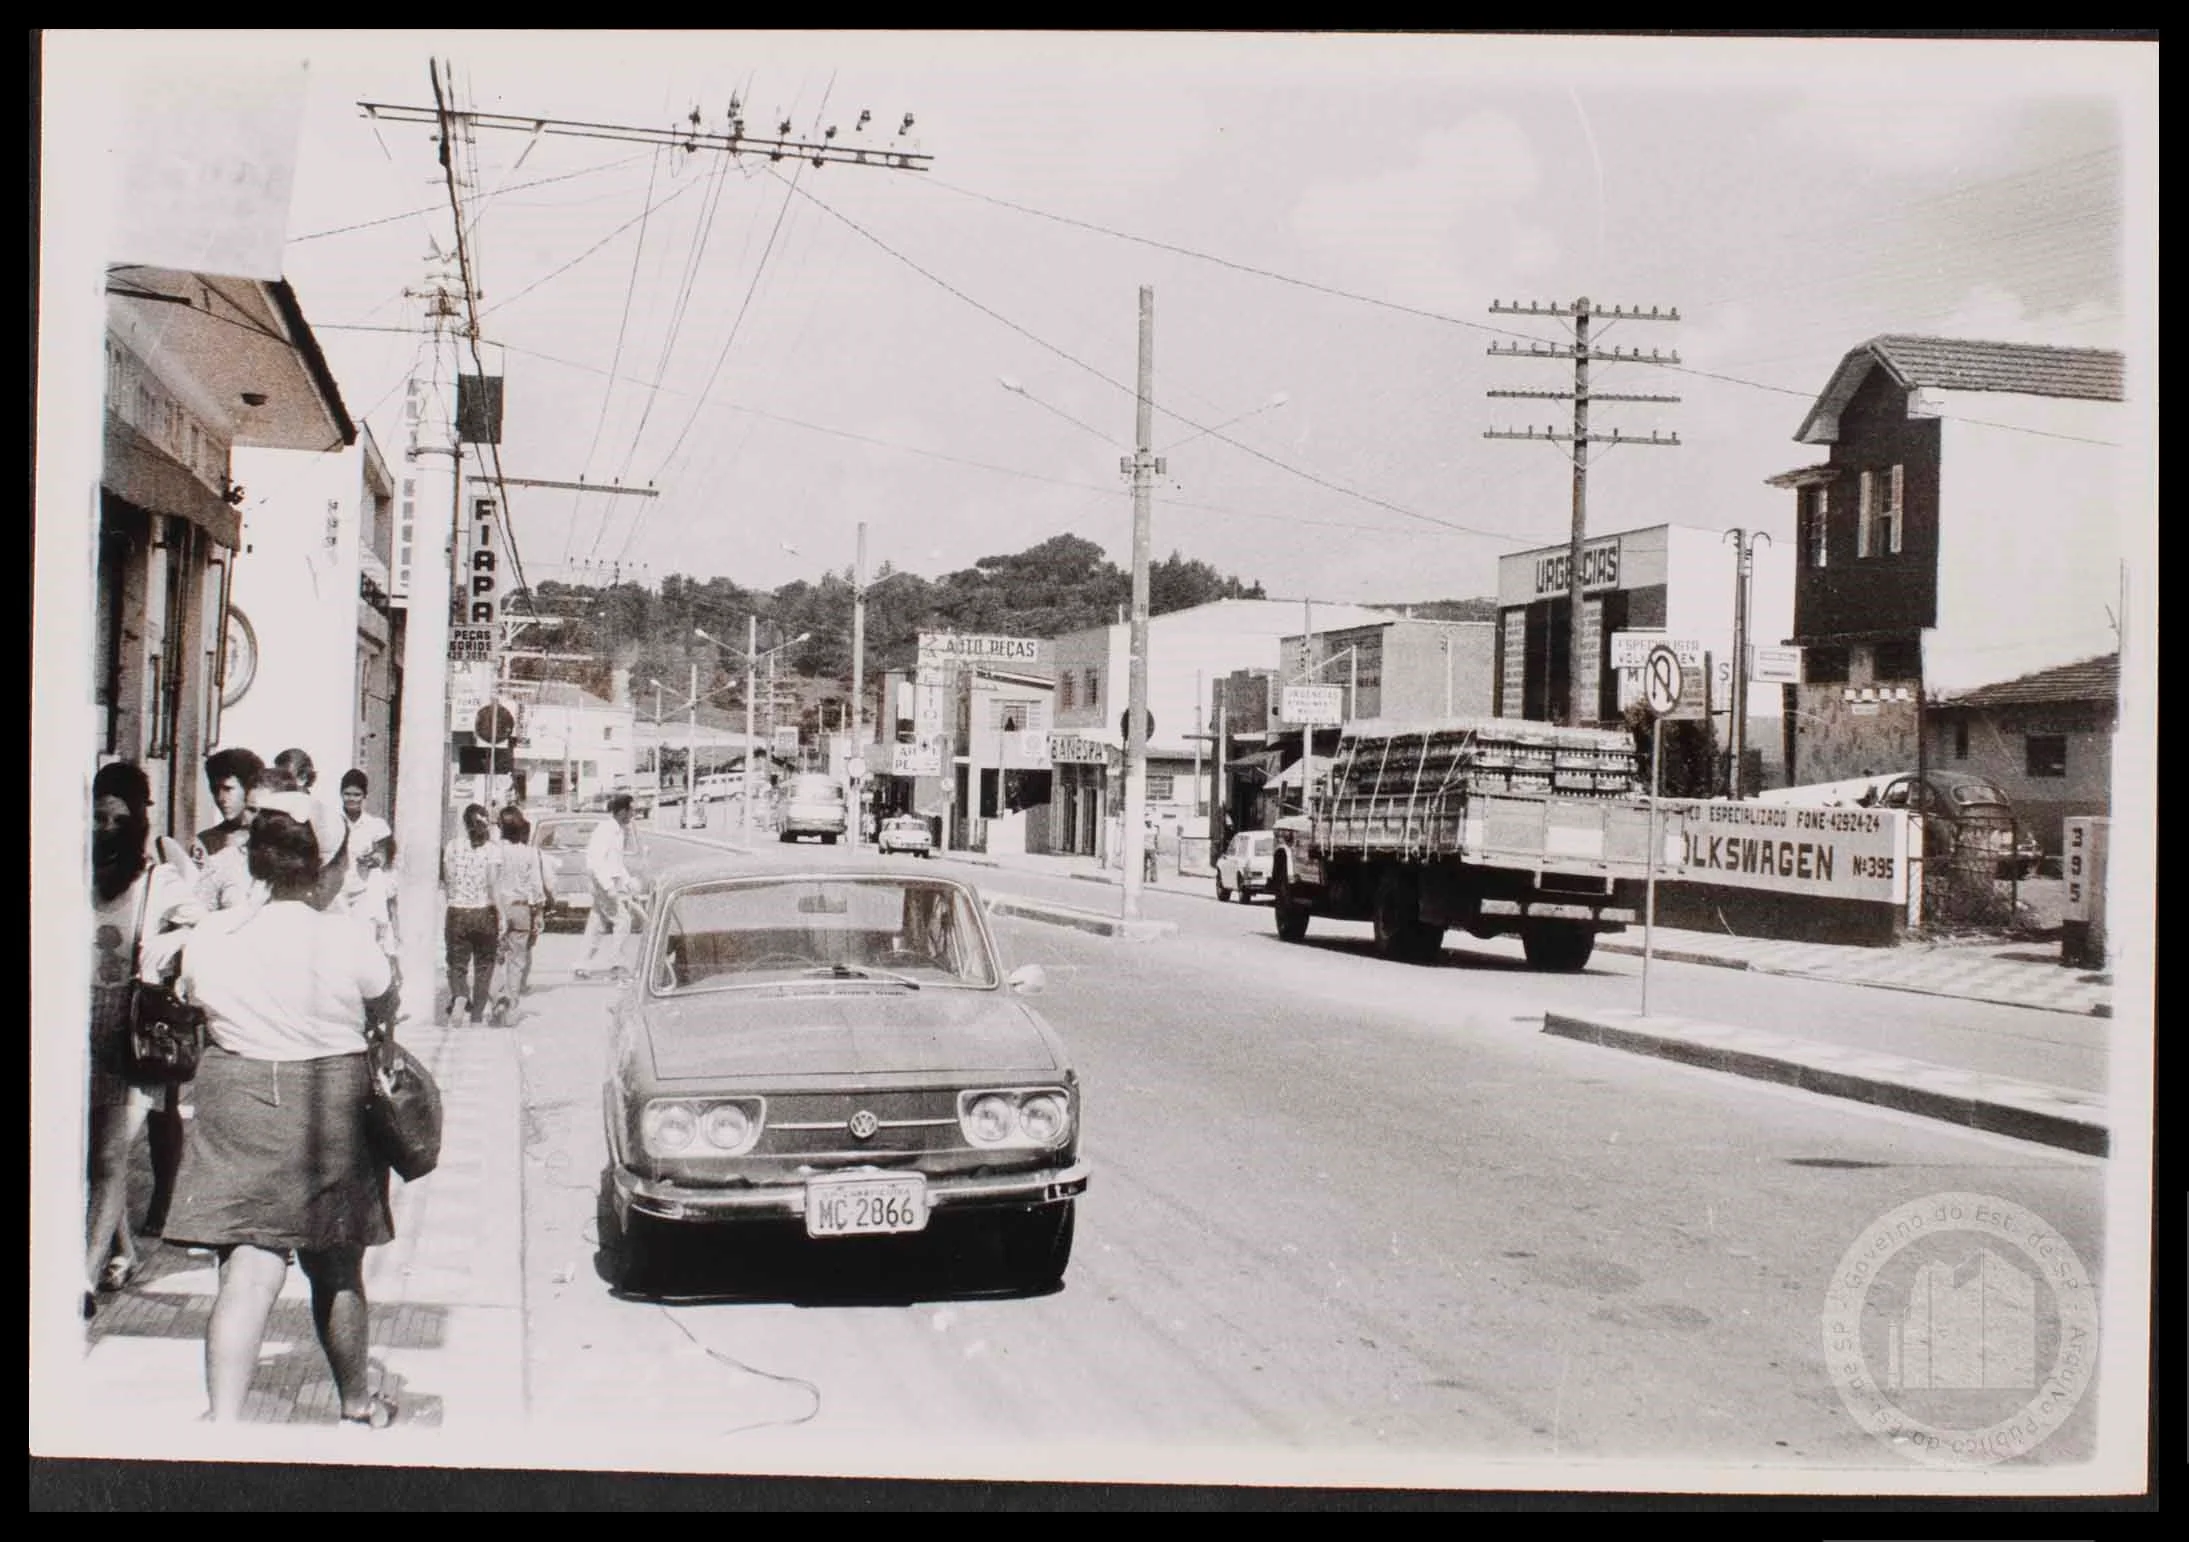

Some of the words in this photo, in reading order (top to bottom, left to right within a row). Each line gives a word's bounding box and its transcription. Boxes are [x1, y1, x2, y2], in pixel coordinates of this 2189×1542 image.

[473, 499, 497, 623] FIAPA
[1536, 546, 1617, 593] URGECIAS
[1709, 805, 1787, 828] ESPECIALIZADO
[1683, 831, 1833, 881] LKSWAGEN
[2069, 827, 2083, 903] 395
[856, 1197, 914, 1227] 2866
